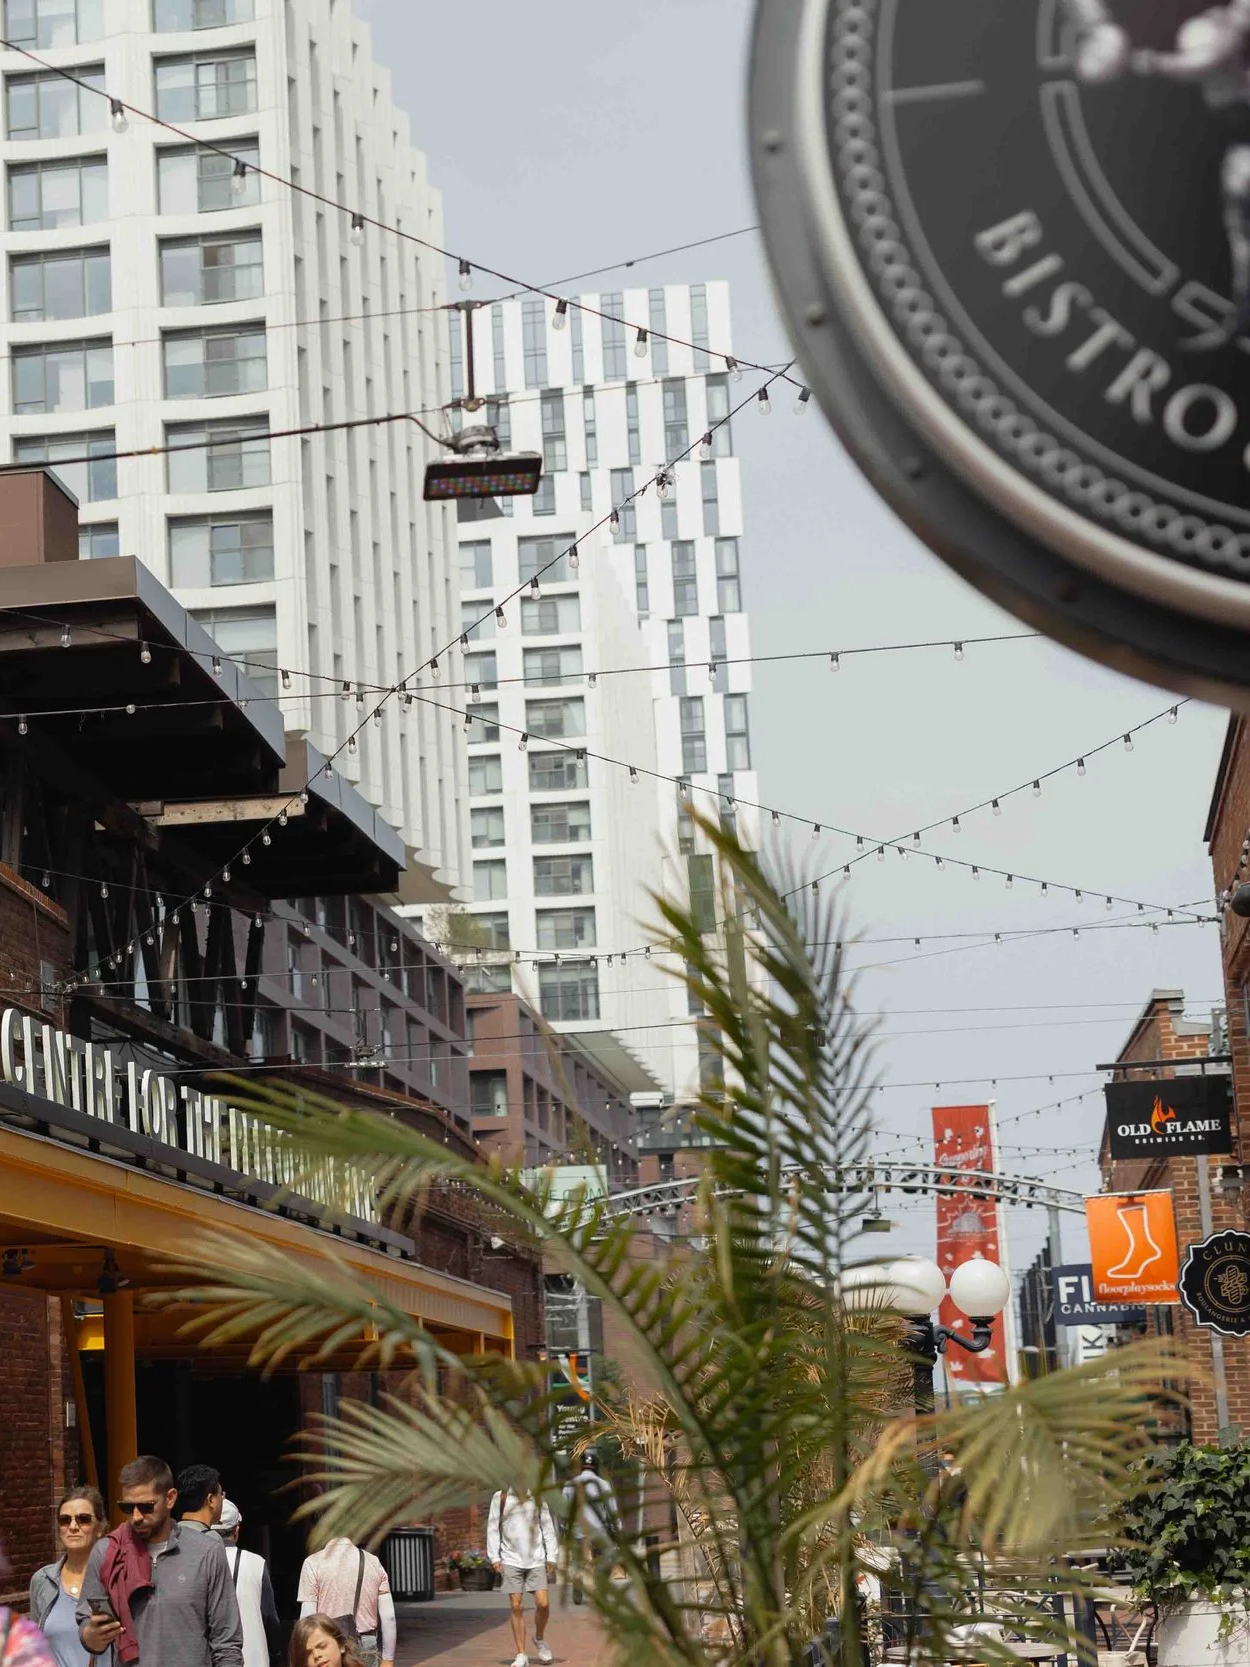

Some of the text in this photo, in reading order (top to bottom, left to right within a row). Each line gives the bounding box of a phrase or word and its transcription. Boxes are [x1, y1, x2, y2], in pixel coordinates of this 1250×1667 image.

[1, 1008, 126, 1128] CENTRE
[127, 1061, 179, 1148] FOR
[180, 1085, 228, 1166] THE
[1117, 1119, 1221, 1136] OLD FLAME
[1098, 1280, 1176, 1295] floorplaysocks
